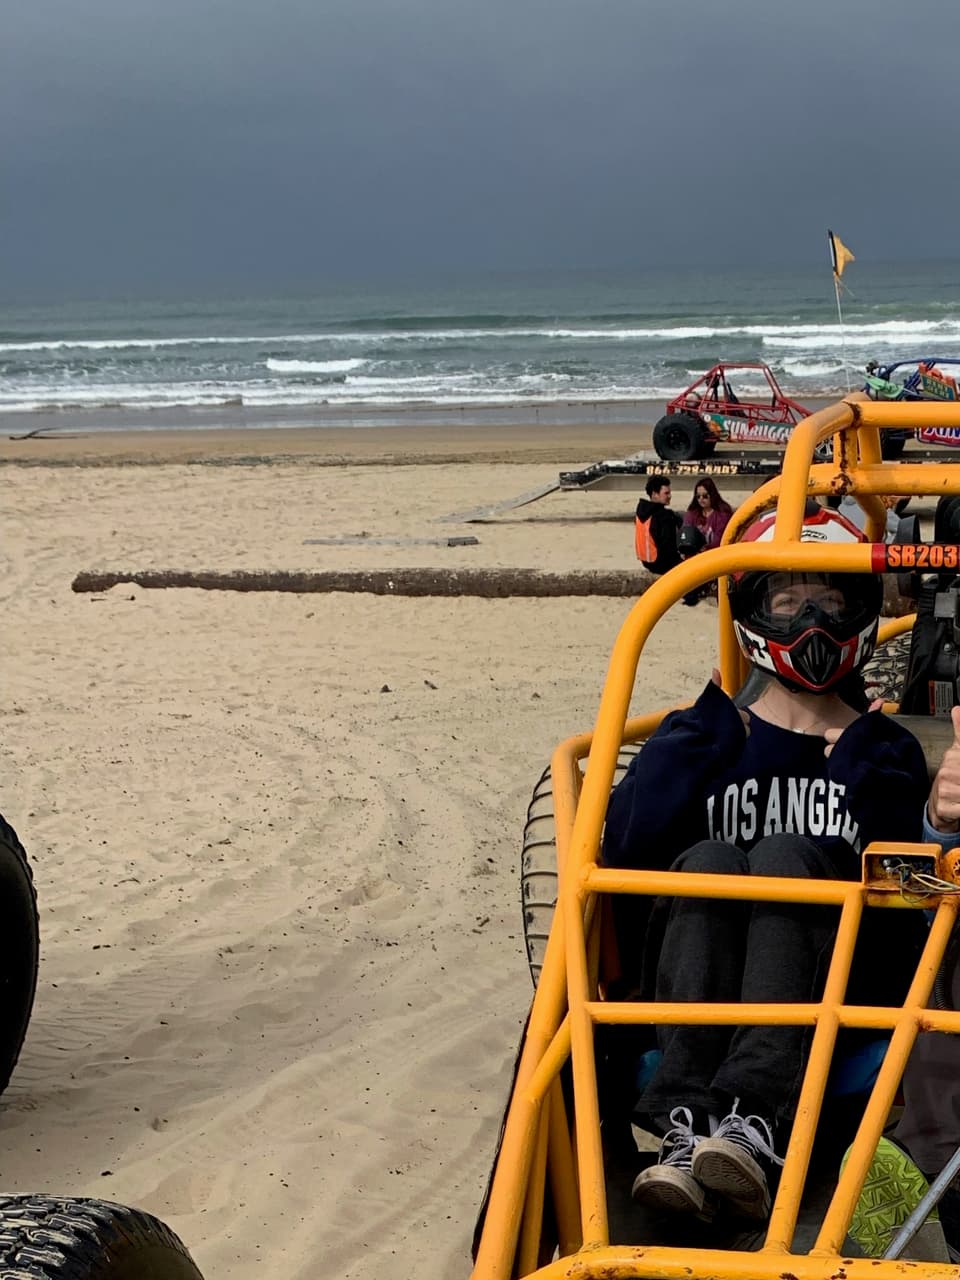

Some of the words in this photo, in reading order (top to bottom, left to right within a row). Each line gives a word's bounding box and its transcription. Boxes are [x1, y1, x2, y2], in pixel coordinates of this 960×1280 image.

[887, 545, 958, 568] SB203
[707, 778, 759, 846] LOS
[763, 776, 861, 855] ANGEL
